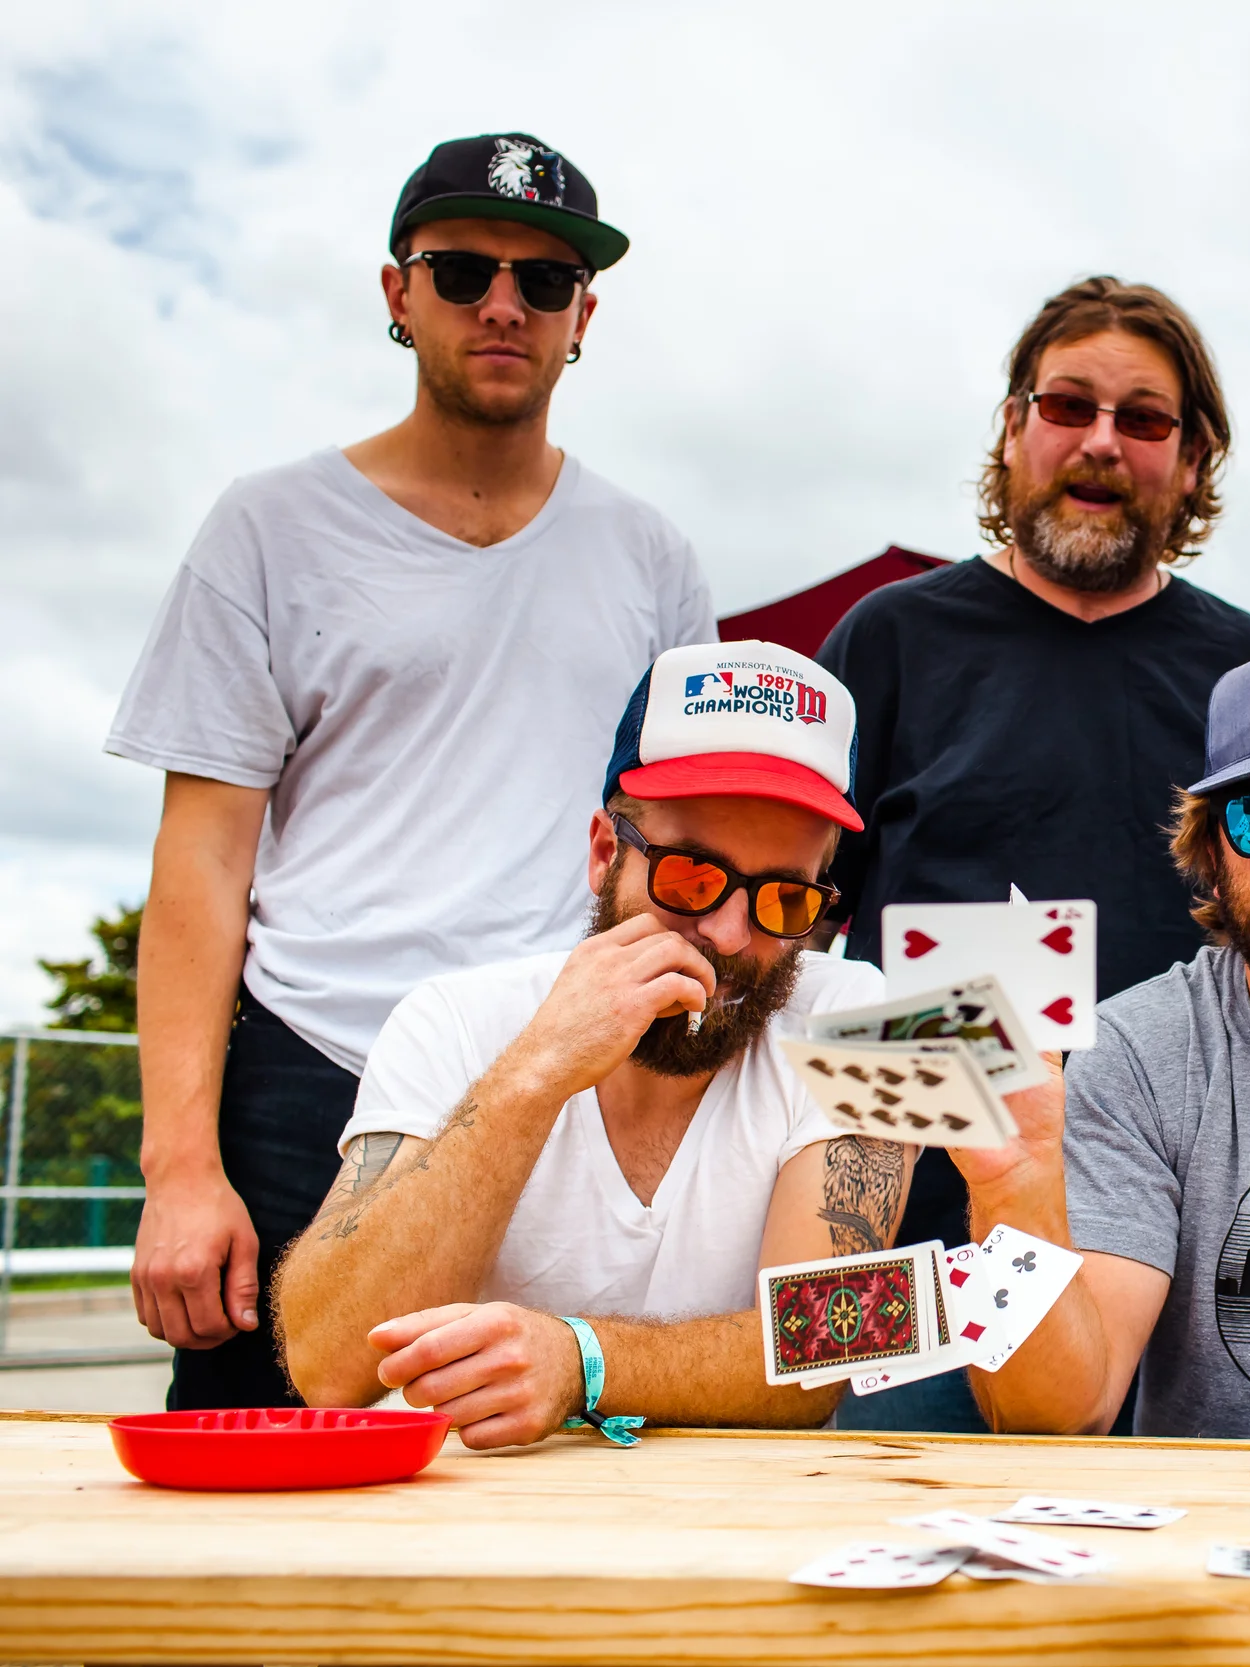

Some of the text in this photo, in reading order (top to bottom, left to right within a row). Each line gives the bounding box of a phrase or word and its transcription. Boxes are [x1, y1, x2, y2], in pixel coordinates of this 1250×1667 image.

[716, 662, 804, 680] MINNESOTA TWINS
[757, 673, 794, 691] 1987
[733, 685, 794, 705] WORLD
[684, 699, 794, 722] CHAMPIONS
[990, 1229, 1004, 1244] 3
